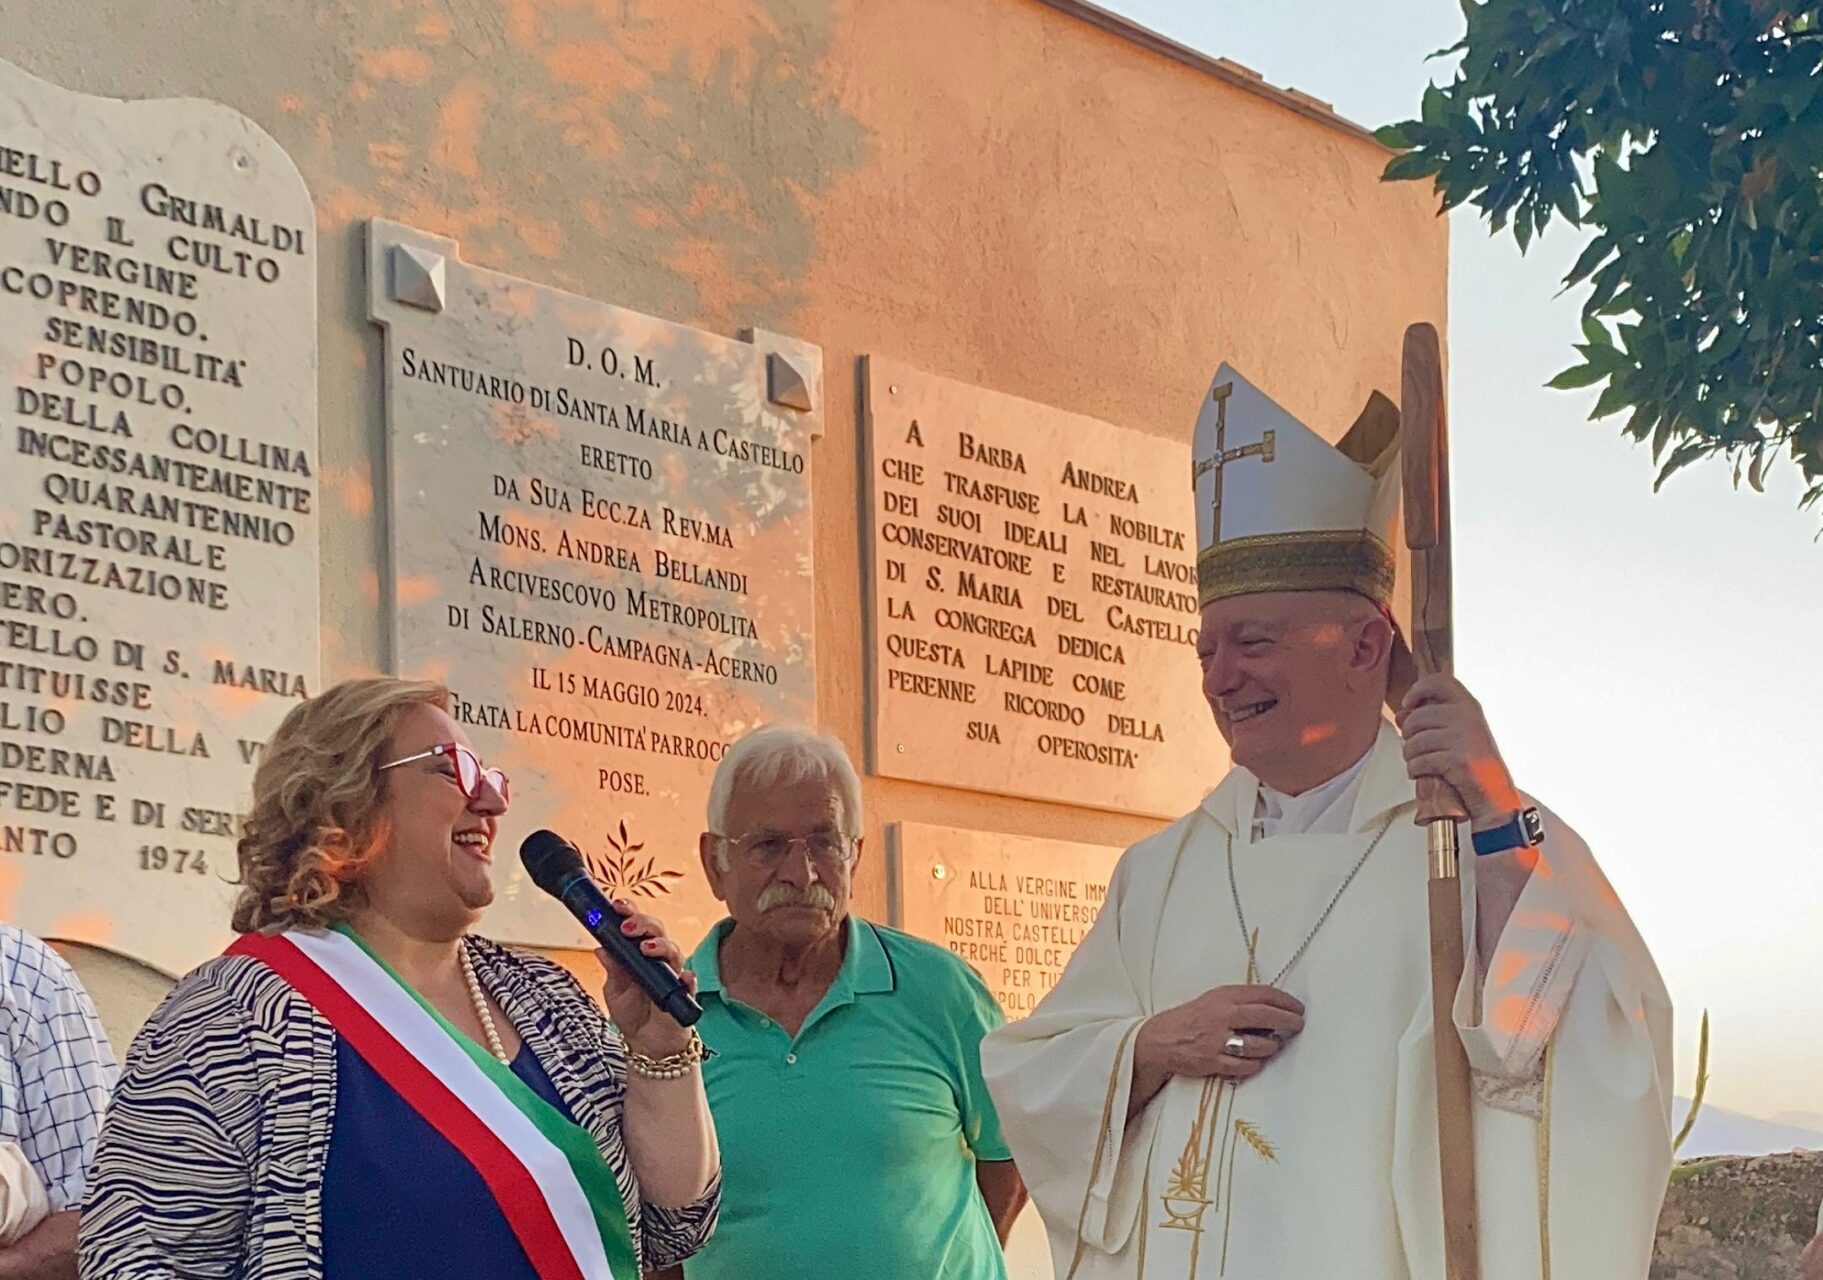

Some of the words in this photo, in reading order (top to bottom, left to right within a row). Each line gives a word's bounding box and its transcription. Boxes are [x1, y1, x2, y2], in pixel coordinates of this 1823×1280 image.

[107, 216, 134, 247] IL
[168, 235, 279, 283] CULTO
[141, 183, 305, 255] GRIMALDI
[46, 238, 198, 300] VERGINE
[2, 266, 208, 341] COPRENDO.
[37, 353, 191, 414] POPOLO.
[567, 337, 592, 370] D.
[600, 347, 624, 380] O.
[633, 355, 661, 388] M.
[17, 386, 133, 437] DELLA
[171, 424, 312, 477] COLLINA
[402, 347, 524, 404] SANTUARIO
[530, 385, 551, 412] DI
[556, 387, 620, 429] SANTA
[625, 406, 692, 448] MARIA
[697, 432, 709, 451] A
[713, 428, 804, 475] CASTELLO
[17, 426, 311, 514] INCESSANTEMENTE
[580, 444, 653, 481] ERETTO
[882, 458, 924, 486] CHE
[944, 471, 1040, 515] TRASFUSE
[1063, 503, 1088, 527] LA
[905, 420, 925, 448] A
[958, 432, 1026, 475] BARBA
[1061, 460, 1139, 504] ANDREA
[34, 508, 227, 571] PASTORALE
[44, 473, 294, 546] QUARANTENNIO
[493, 474, 520, 501] DA
[530, 478, 572, 514] SUA
[582, 489, 652, 531] ECC.ZA
[663, 506, 734, 549] REV.MA
[883, 491, 918, 518] DEI
[937, 503, 982, 534] SUOI
[1004, 520, 1068, 554] IDEALI
[1091, 541, 1125, 568] NEL
[0, 542, 228, 610] ORIZZAZIONE
[478, 511, 546, 553] MONS.
[557, 529, 641, 574] ANDREA
[654, 550, 748, 596] BELLANDI
[883, 522, 1032, 576] CONSERVATORE
[1053, 563, 1065, 583] E
[2, 581, 87, 622] ERO.
[448, 605, 469, 630] DI
[469, 557, 616, 612] ARCIVESCOVO
[626, 588, 758, 640] METROPOLITA
[886, 559, 906, 584] DI
[926, 565, 945, 594] S.
[958, 570, 1023, 610] MARIA
[1047, 596, 1084, 623] DEL
[1107, 605, 1200, 647] CASTELLO
[887, 597, 916, 622] LA
[935, 607, 1037, 647] CONGREGA
[1058, 634, 1125, 665] DEDICA
[114, 639, 144, 671] DI
[163, 650, 189, 679] S.
[213, 659, 307, 699] MARIA
[532, 667, 550, 690] IL
[559, 672, 576, 694] 15
[582, 676, 659, 708] MAGGIO
[666, 691, 708, 717] 2024.
[887, 633, 965, 669] QUESTA
[985, 654, 1054, 688] LAPIDE
[1073, 673, 1126, 701] COME
[0, 702, 65, 735] LIO
[102, 716, 209, 758] DELLA
[516, 710, 542, 735] LA
[546, 715, 646, 751] COMUNITA'
[888, 669, 976, 704] PERENNE
[1004, 691, 1084, 726] RICORDO
[1108, 713, 1164, 742] DELLA
[966, 721, 1001, 744] SUA
[0, 741, 116, 782] DERNA
[599, 769, 649, 796] POSE.
[96, 794, 116, 821] E
[133, 798, 164, 829] DI
[0, 825, 77, 858] NTO
[139, 845, 208, 875] 1974
[970, 870, 1007, 892] ALLA
[1016, 876, 1077, 899] VERGINE
[984, 896, 1024, 917] DELL'
[1031, 903, 1098, 924] UNIVERSO
[944, 916, 1004, 939] NOSTRA
[1013, 923, 1085, 945] CASTELL
[1016, 946, 1062, 967] DOLCE
[1003, 968, 1031, 988] PER
